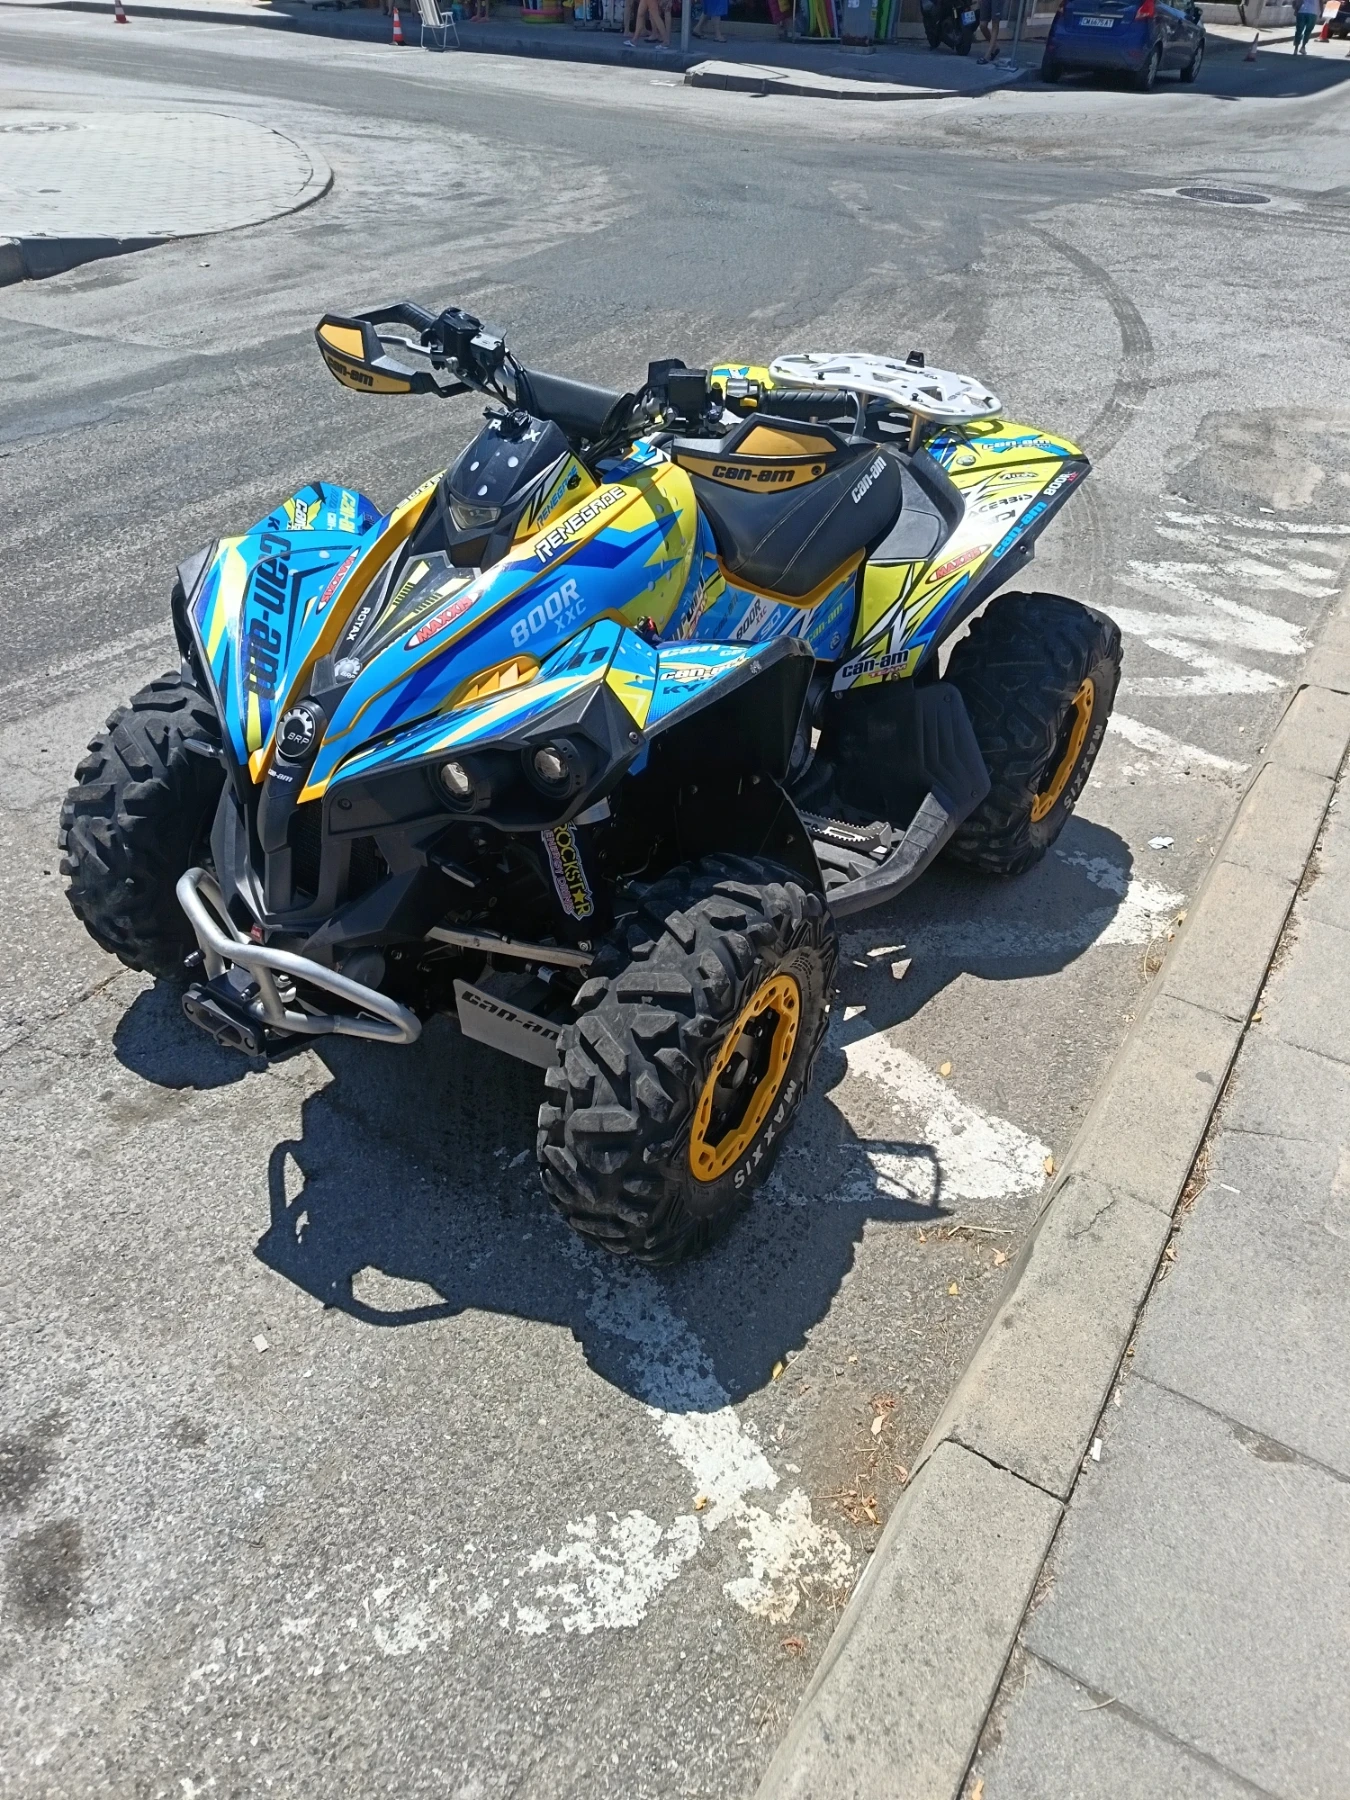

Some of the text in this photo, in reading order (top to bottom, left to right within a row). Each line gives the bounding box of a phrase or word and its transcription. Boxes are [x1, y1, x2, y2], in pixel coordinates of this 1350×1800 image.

[326, 355, 374, 387] can-am
[712, 465, 796, 483] can-am
[851, 456, 887, 504] can-am
[534, 486, 627, 563] RENEGADE
[992, 501, 1049, 559] can-am
[245, 533, 292, 700] can-am
[346, 606, 371, 641] ROTAX
[415, 596, 473, 644] MAXXIS
[510, 578, 580, 648] 800R
[554, 598, 587, 634] XXC
[736, 598, 762, 640] 800R
[807, 603, 843, 642] can-am
[340, 671, 356, 679] BRP
[842, 650, 909, 678] can-am
[287, 732, 310, 744] BRP
[267, 768, 294, 783] can-am
[1063, 724, 1103, 810] MAXXIS
[734, 1079, 797, 1189] MAXXIS
